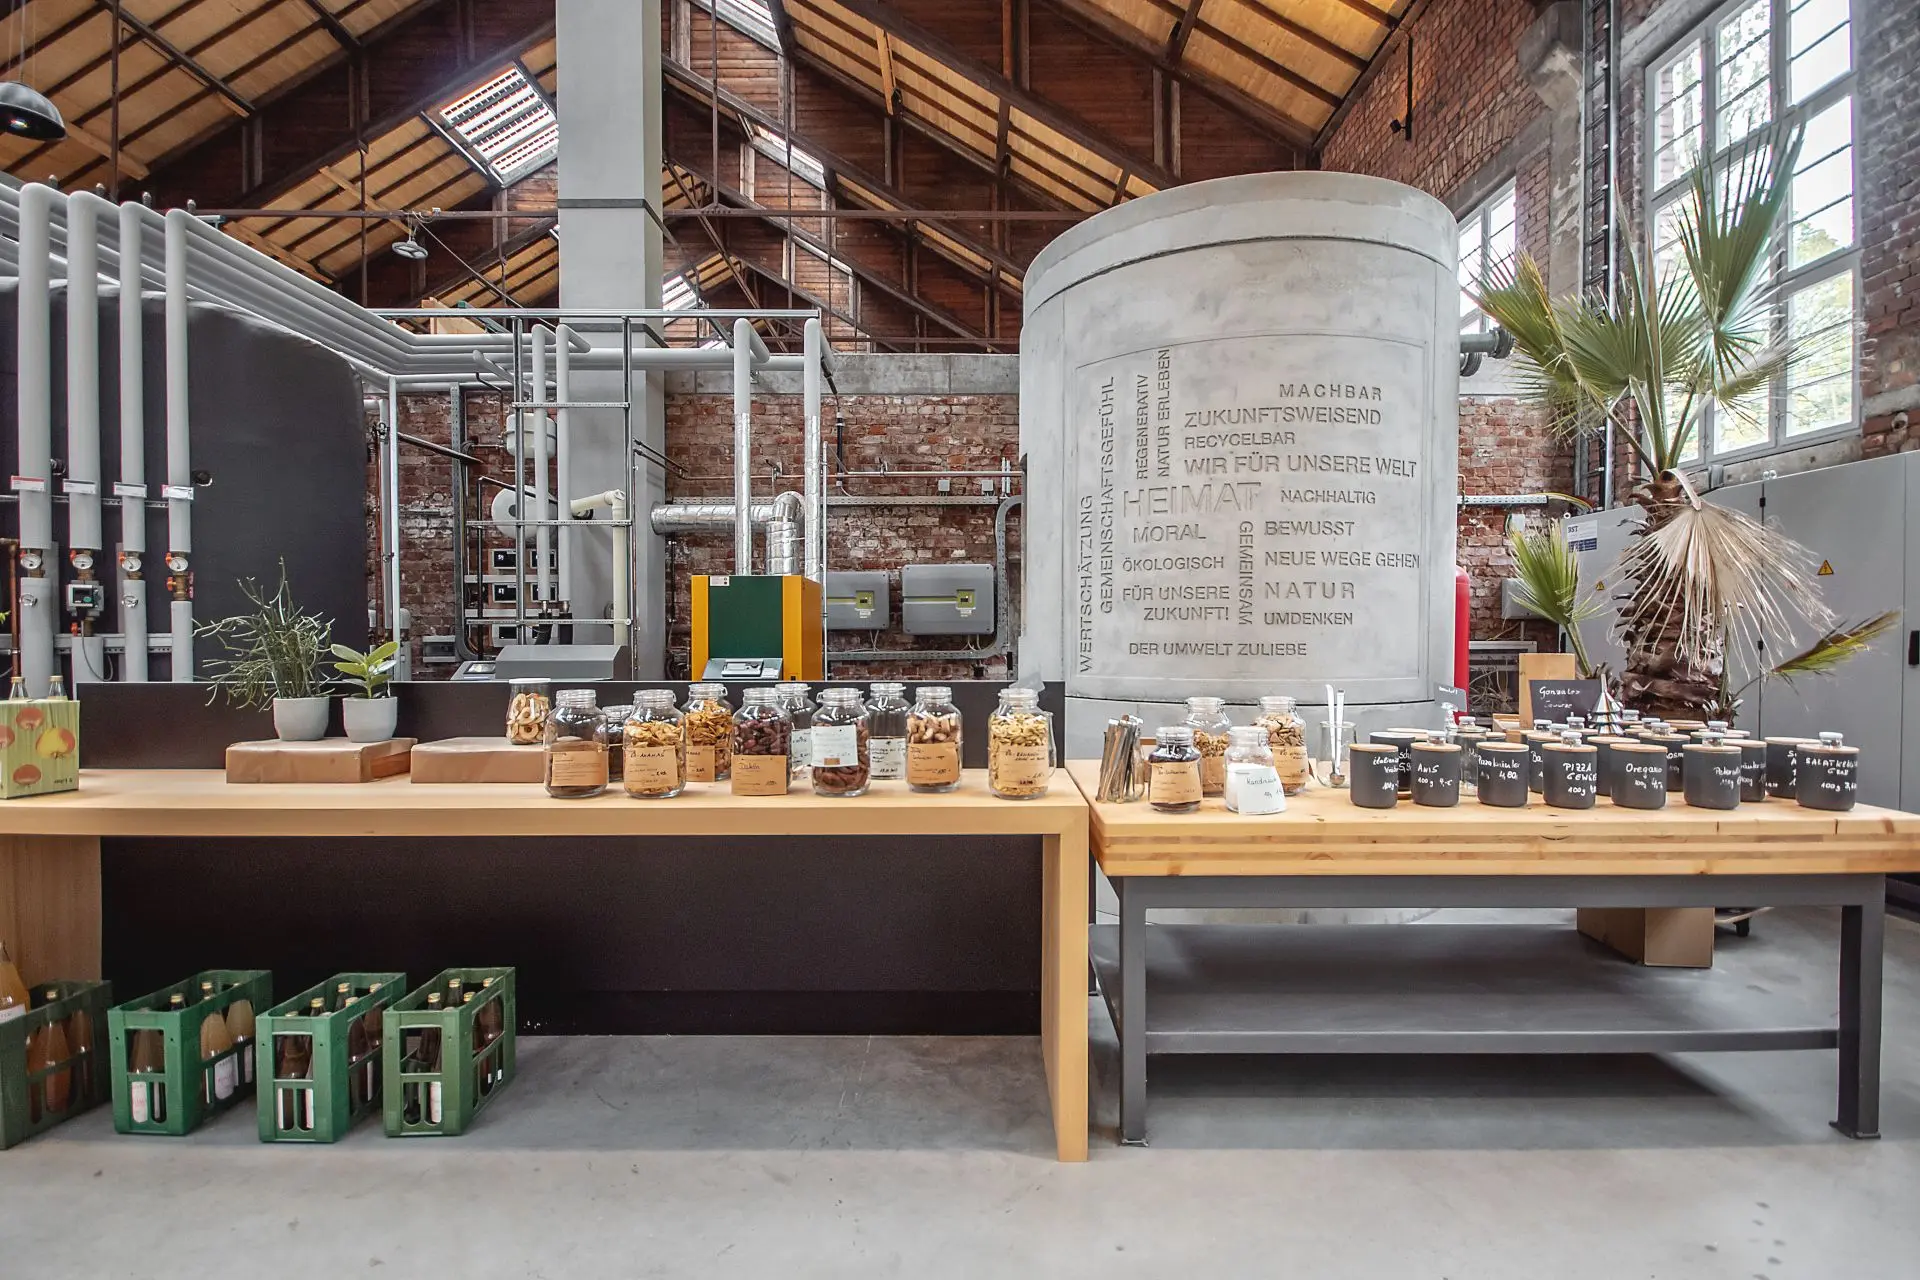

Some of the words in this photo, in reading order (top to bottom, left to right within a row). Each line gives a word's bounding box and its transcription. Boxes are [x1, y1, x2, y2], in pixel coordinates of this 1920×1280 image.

[1157, 349, 1170, 421] ERLEBEN
[1279, 384, 1383, 401] MACHBAR
[1184, 406, 1382, 428] ZUKUNFTSWEISEND
[1136, 374, 1149, 480] REGENERATIV
[1184, 431, 1296, 449] RECYCELBAR
[1157, 425, 1170, 478] NATUR
[1184, 456, 1228, 475] WIR
[1234, 452, 1280, 474] FÜR
[1287, 454, 1371, 475] UNSERE
[1375, 457, 1417, 479] WELT
[1098, 376, 1114, 614] GEMEINSCHAFTSGEFÜHL
[1123, 482, 1262, 518] HEIMAT
[1280, 489, 1376, 505] NACHHALTIG
[1133, 523, 1207, 543] MORAL
[1263, 520, 1355, 536] BEWUSST
[1122, 556, 1225, 571] ÖKOLOGISCH
[1264, 551, 1316, 567] NEUE
[1321, 551, 1371, 568] WEGE
[1375, 552, 1421, 569] GEHEN
[1238, 520, 1254, 625] GEMEINSAM
[1077, 495, 1093, 673] WERTSCHÄTZUNG
[1122, 585, 1154, 601] FÜR
[1158, 586, 1230, 600] UNSERE
[1264, 581, 1355, 600] NATUR
[1144, 607, 1229, 621] ZUKUNFT!
[1263, 611, 1354, 626] UMDENKEN
[1129, 642, 1159, 655] DER
[1163, 643, 1233, 656] UMWELT
[1237, 643, 1308, 656] ZULIEBE
